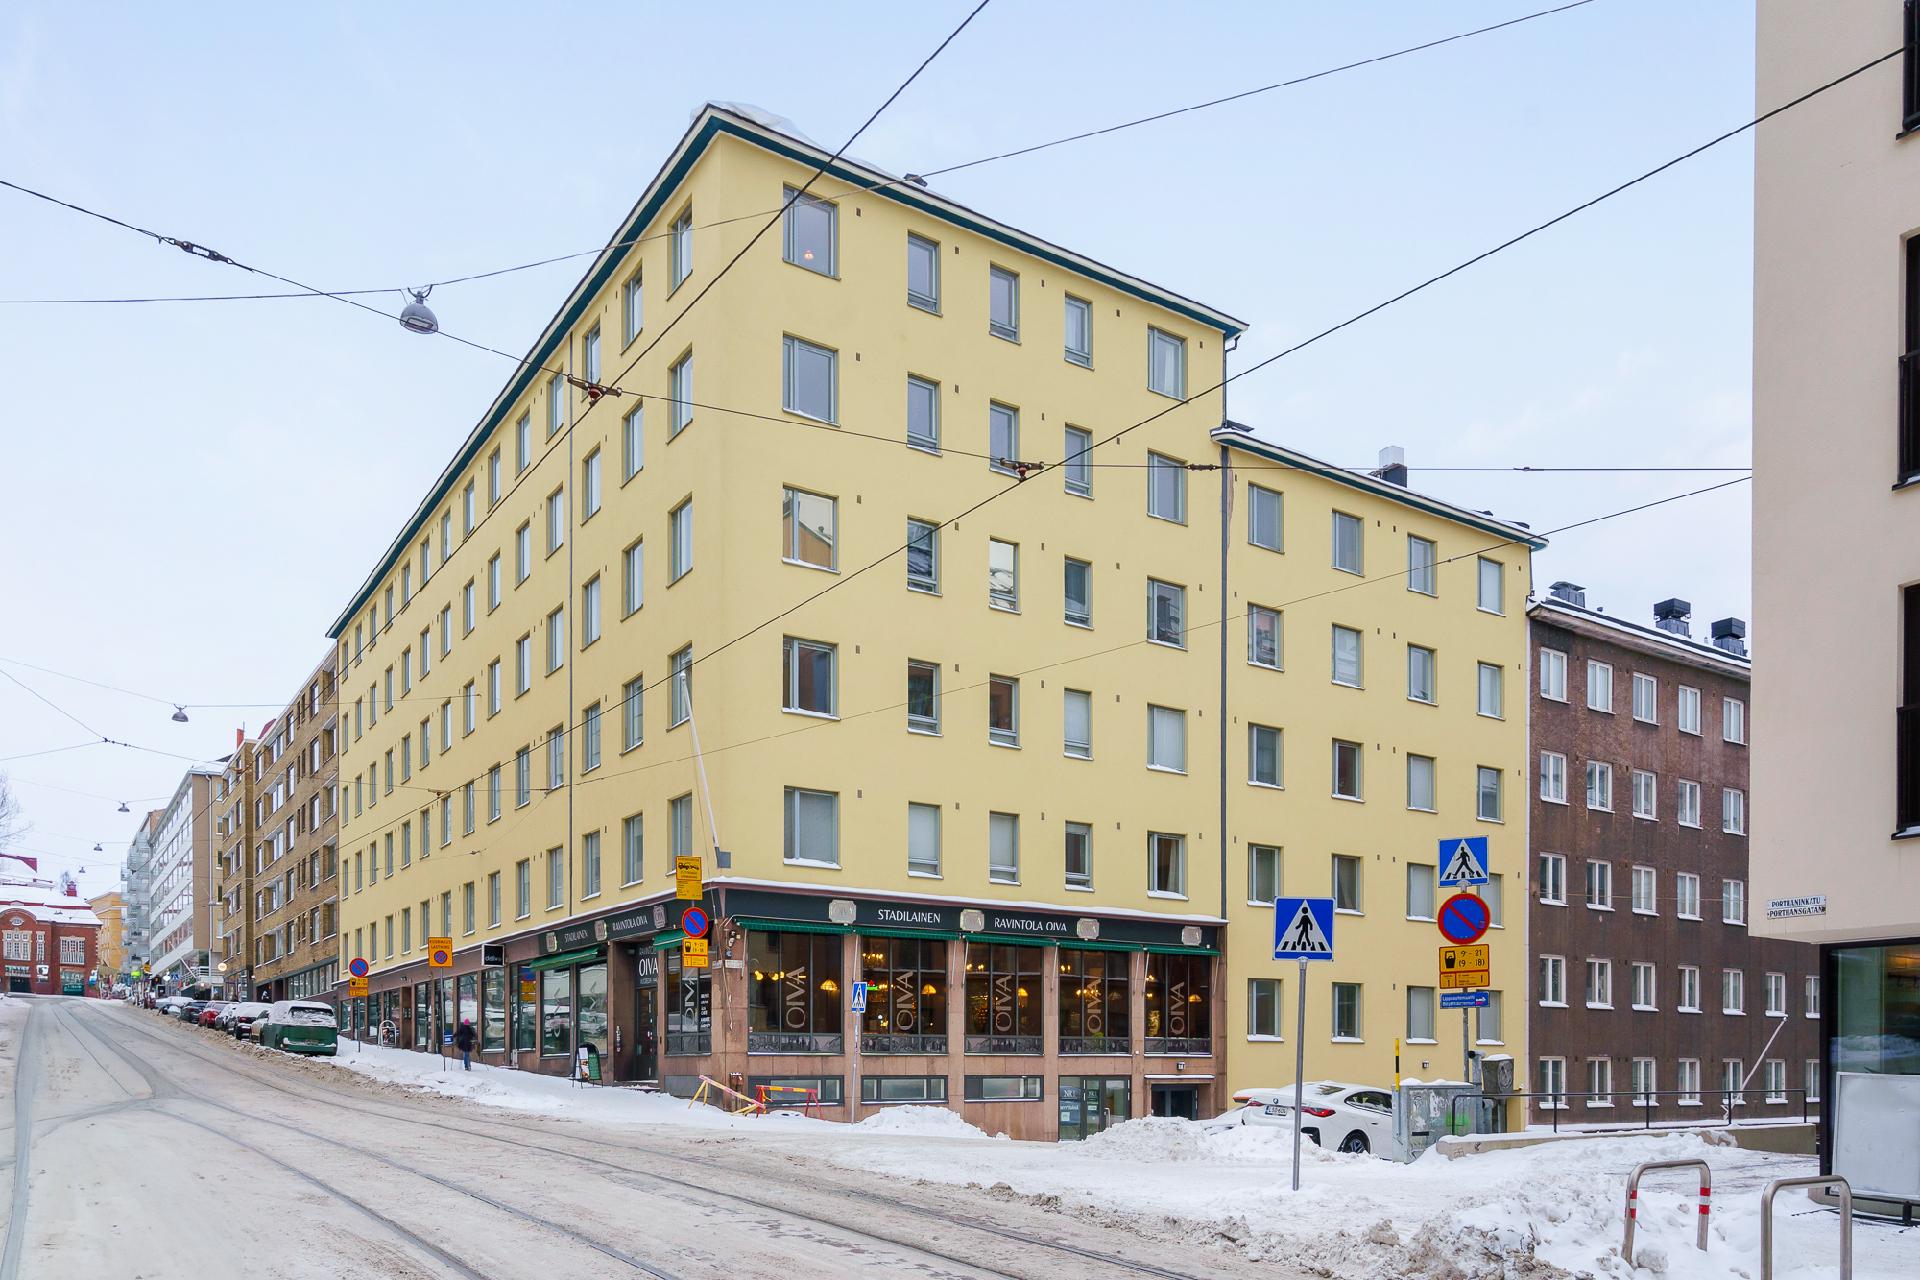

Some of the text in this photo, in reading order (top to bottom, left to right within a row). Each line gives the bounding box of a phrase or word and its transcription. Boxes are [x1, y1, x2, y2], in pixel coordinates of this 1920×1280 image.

[878, 909, 941, 923] STADILAINEN
[994, 917, 1043, 931] RAVINTOLA
[1045, 921, 1067, 932] OIVA
[638, 957, 659, 977] OIVA
[1475, 959, 1485, 967] 18)
[786, 966, 806, 1028] OIVA
[896, 971, 913, 1030] OIVA
[995, 975, 1012, 1031] OIVA
[1087, 978, 1102, 1033] OIVA
[1170, 981, 1185, 1034] OIVA
